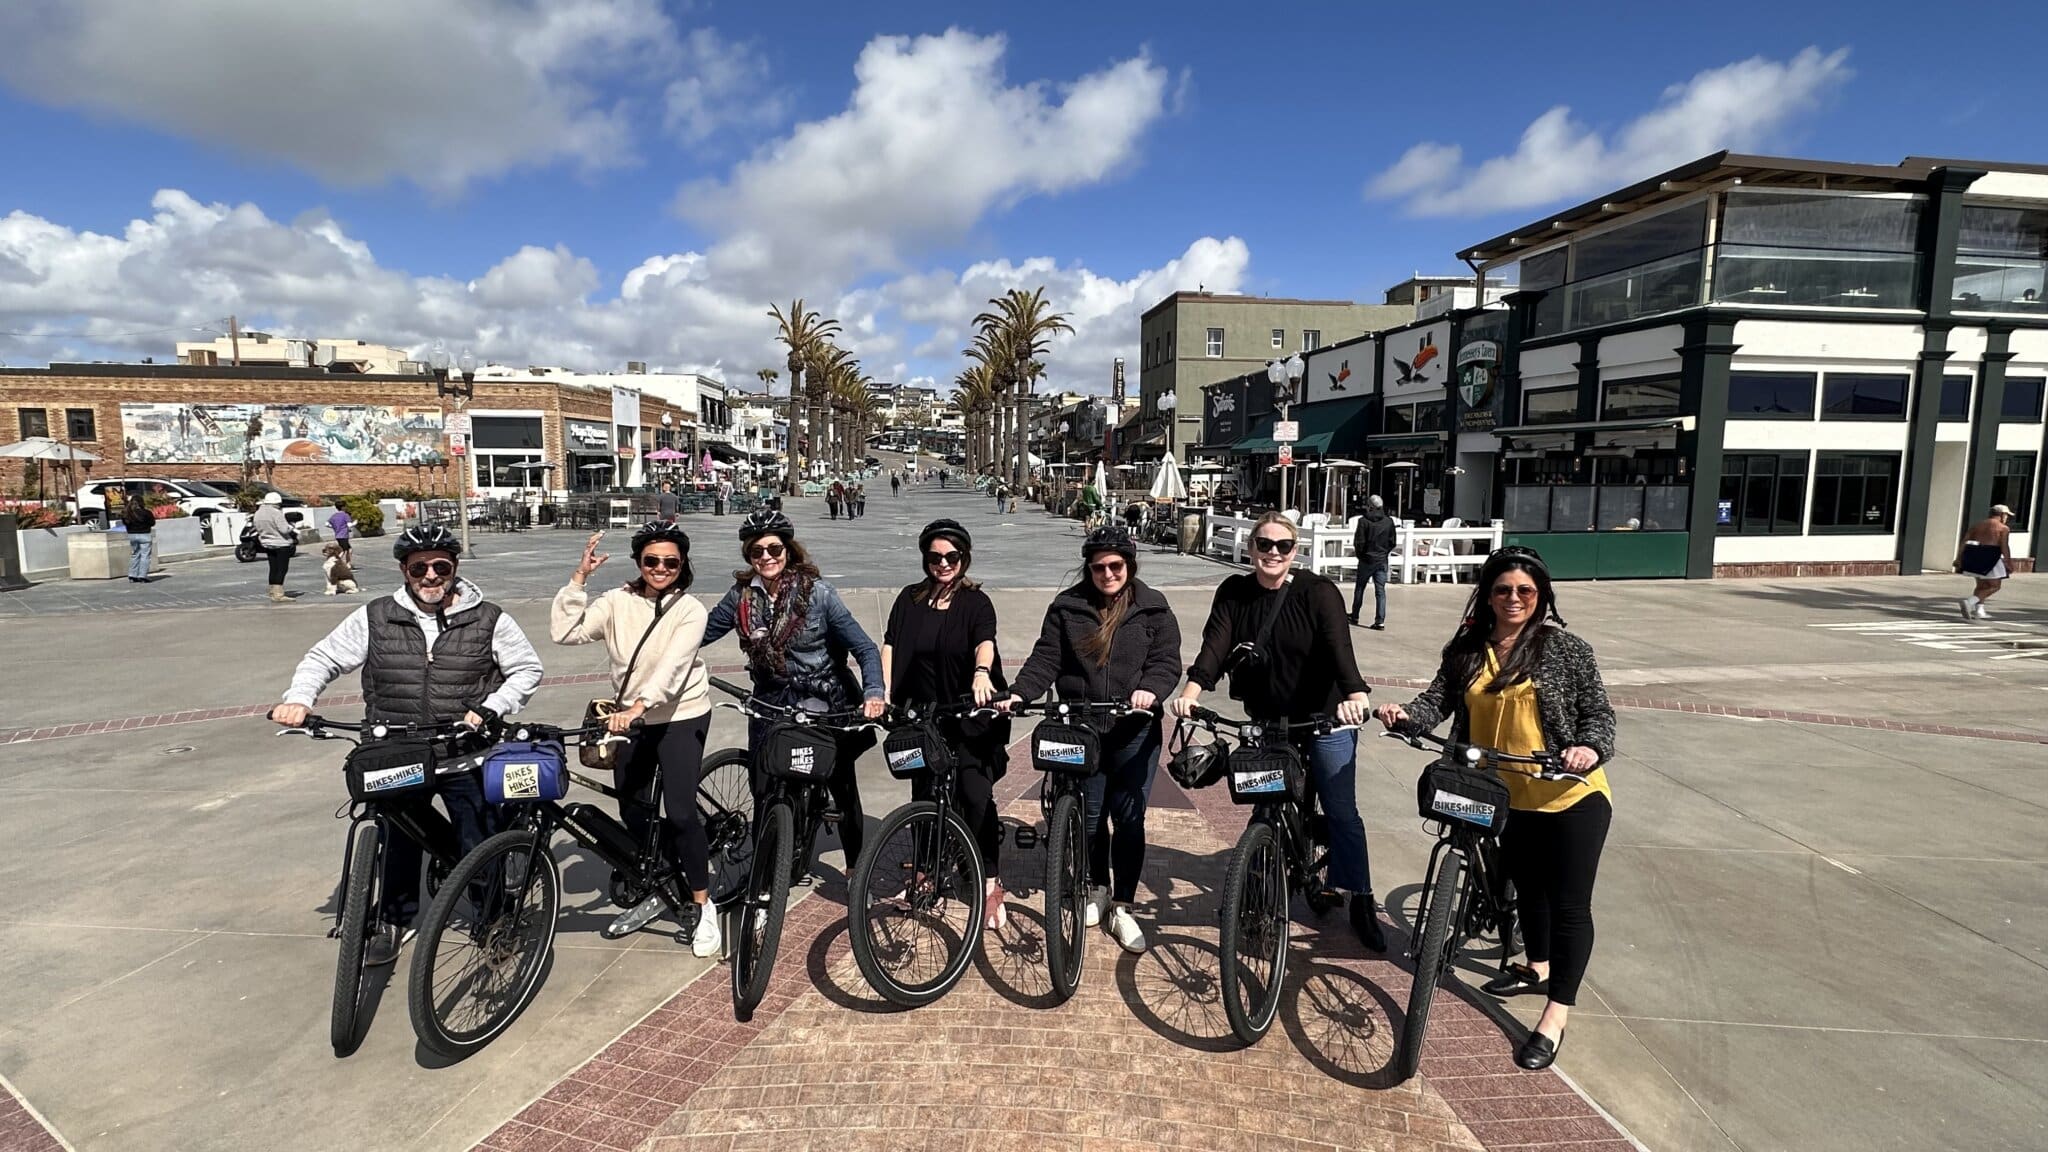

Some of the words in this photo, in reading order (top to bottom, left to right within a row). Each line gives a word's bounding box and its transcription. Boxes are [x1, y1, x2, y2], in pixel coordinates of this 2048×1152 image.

[791, 748, 814, 757] BIKES
[791, 756, 815, 766] HIKES
[505, 766, 533, 782] BIKES
[508, 776, 537, 792] HIKES
